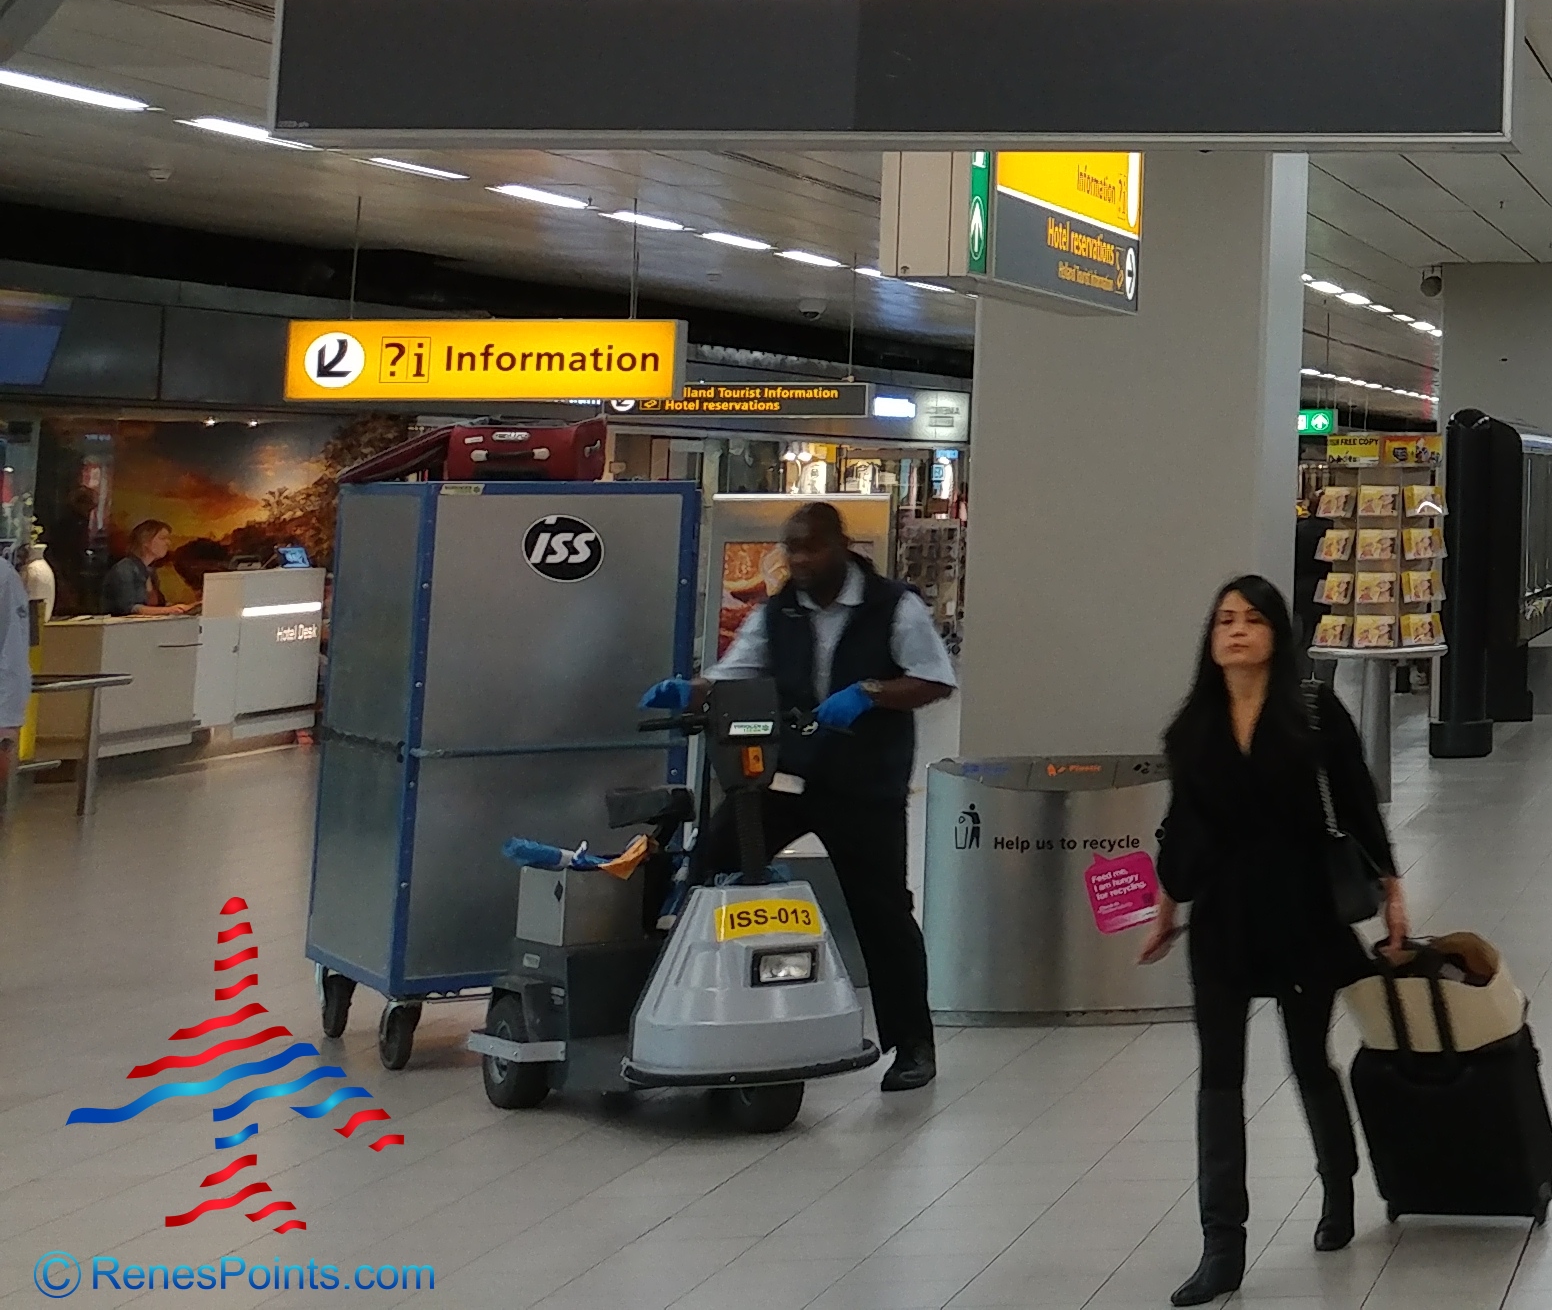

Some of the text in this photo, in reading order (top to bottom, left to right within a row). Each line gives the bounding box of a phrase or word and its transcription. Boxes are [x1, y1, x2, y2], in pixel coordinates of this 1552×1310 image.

[1077, 165, 1116, 205] Information
[1047, 217, 1115, 266] Hotel reservations
[445, 343, 661, 373] Information
[718, 387, 761, 398] Tourist
[764, 387, 839, 399] Information
[664, 399, 781, 411] Hotel reservations
[1358, 438, 1379, 446] COPY
[993, 834, 1140, 854] Help us to recycle
[1091, 872, 1112, 884] Feed
[1099, 883, 1111, 891] am
[1112, 874, 1139, 887] hungry
[1096, 892, 1108, 901] for
[729, 907, 813, 930] ISS-013
